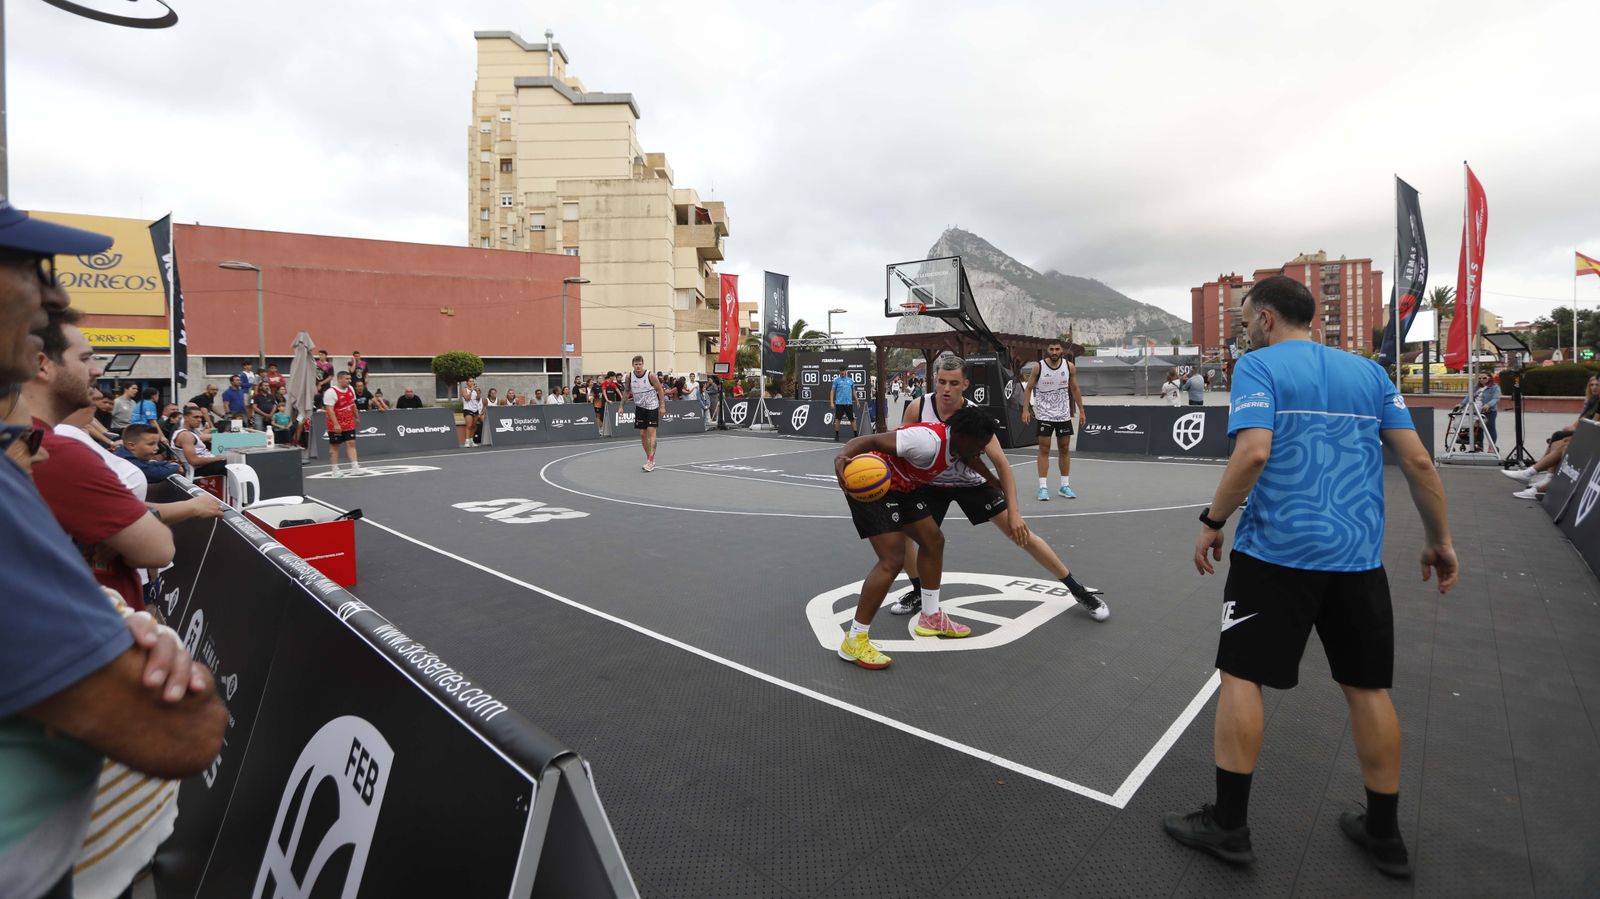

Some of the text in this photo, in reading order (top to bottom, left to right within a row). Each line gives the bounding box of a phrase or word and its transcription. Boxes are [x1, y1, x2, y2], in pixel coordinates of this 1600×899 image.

[1405, 247, 1417, 281] ARMAS
[57, 271, 157, 291] ORREOS
[804, 372, 817, 383] 08
[822, 373, 842, 383] 01:2
[1005, 579, 1070, 597] FEB
[373, 620, 509, 721] www.3x3series.com
[344, 736, 380, 807] FEB
